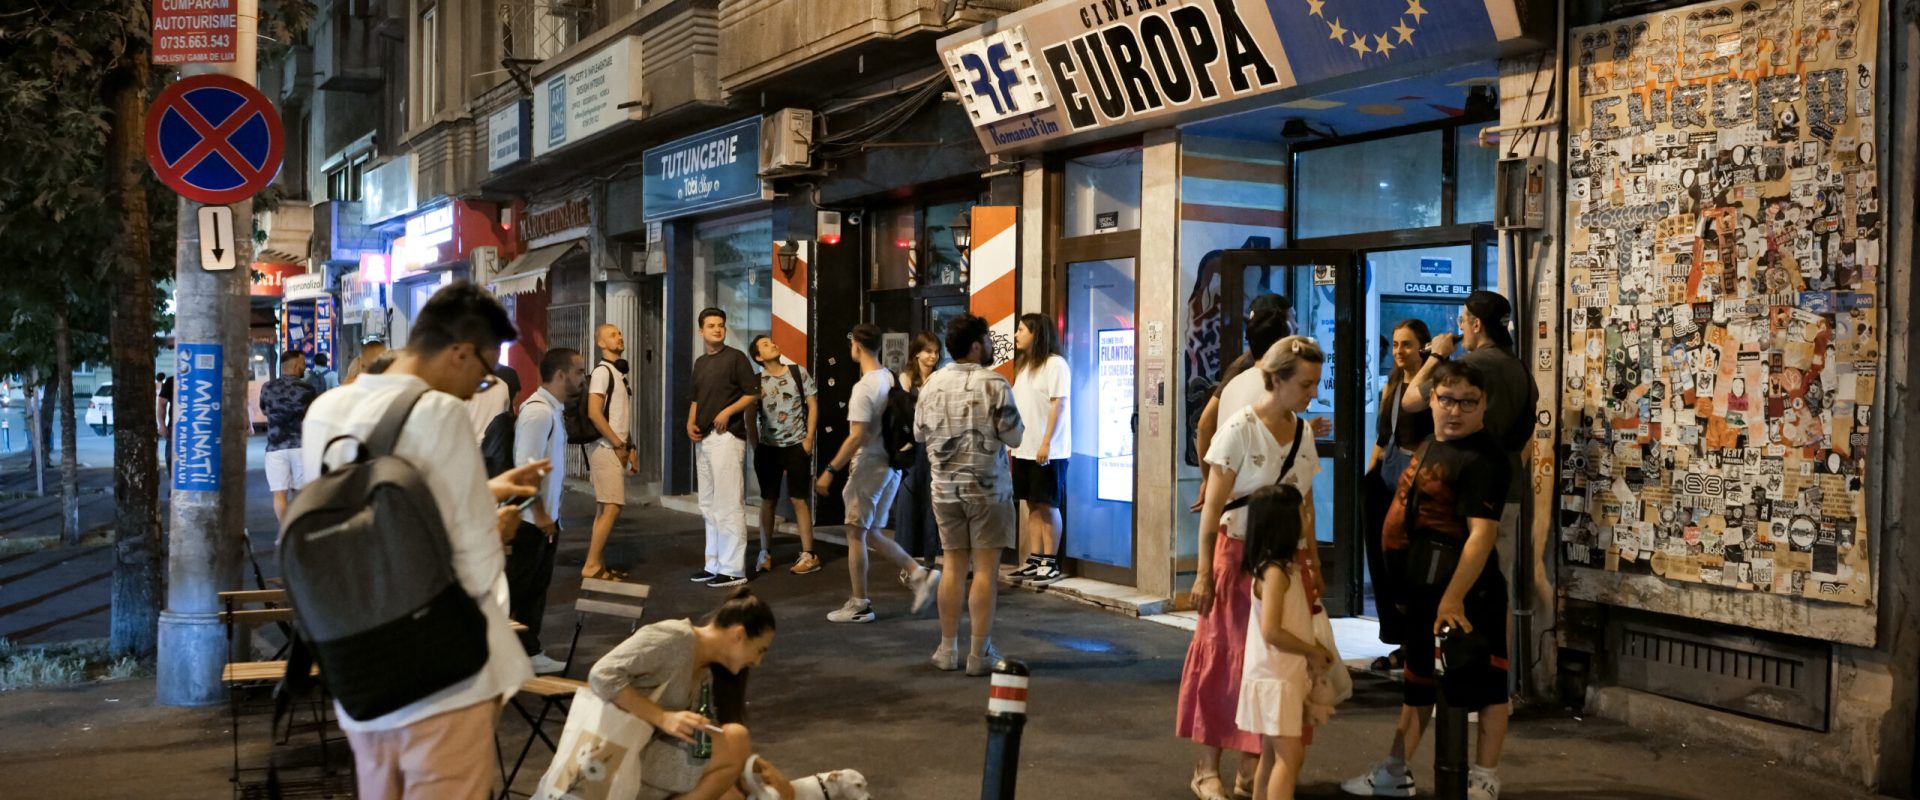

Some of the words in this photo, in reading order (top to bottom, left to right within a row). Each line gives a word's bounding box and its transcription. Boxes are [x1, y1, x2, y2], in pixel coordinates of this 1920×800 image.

[161, 0, 229, 11] CUMPARAM
[154, 15, 237, 31] AUTOTURISME
[160, 34, 230, 49] 0735.663.543
[153, 54, 185, 62] INCLUSIV
[209, 53, 219, 61] DE
[221, 52, 235, 61] LUX
[1042, 0, 1281, 131] EUROPA
[988, 113, 1059, 145] RomaniaFilm
[661, 135, 738, 181] TUTUNGERIE
[1405, 283, 1433, 293] CASA
[1435, 285, 1449, 293] DE
[179, 377, 189, 391] LA
[179, 395, 189, 422] SALA
[178, 425, 188, 484] PALATULUI
[1721, 447, 1744, 458] VERY
